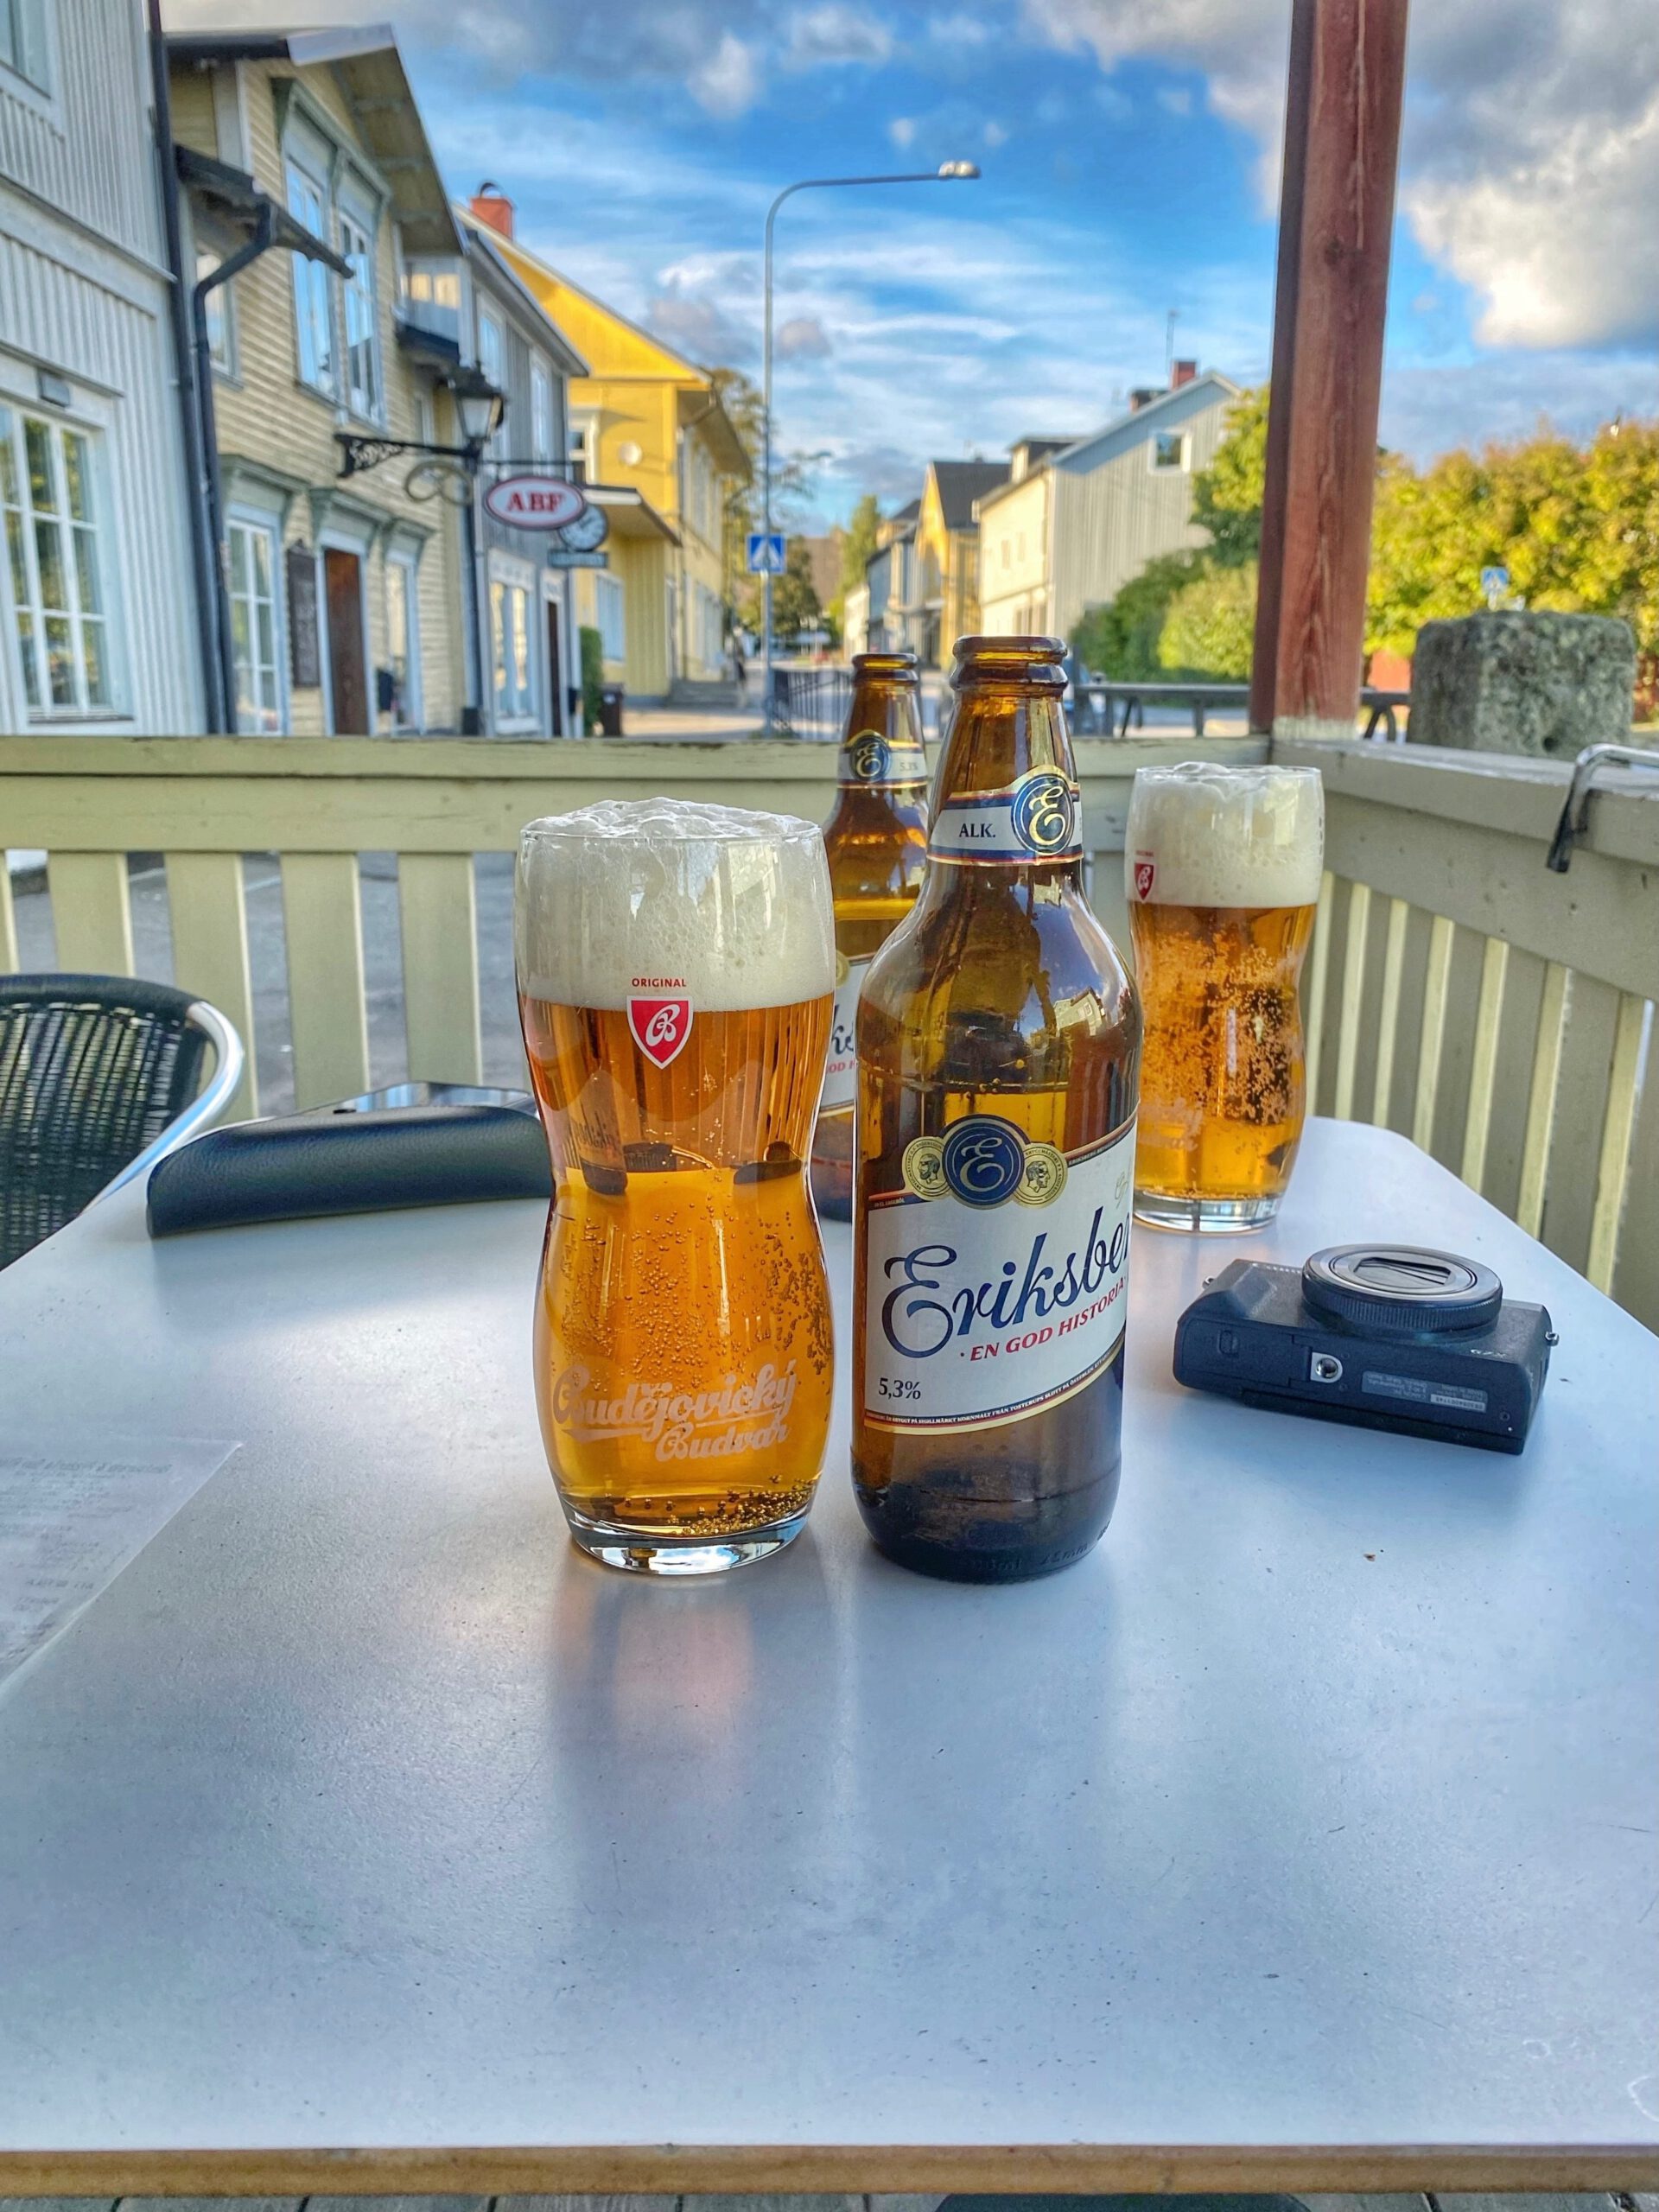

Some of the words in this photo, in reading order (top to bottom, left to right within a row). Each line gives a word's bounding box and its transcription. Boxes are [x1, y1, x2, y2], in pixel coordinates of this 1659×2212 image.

[506, 490, 566, 513] ABF
[958, 823, 996, 838] ALK.
[632, 978, 687, 988] ORIGINAL
[826, 1062, 846, 1074] OD
[969, 1341, 1000, 1362] EN
[1005, 1326, 1053, 1354] GOD
[1058, 1277, 1124, 1338] HISTORIA
[878, 1377, 921, 1401] 5,3%
[655, 1420, 790, 1462] Budvar
